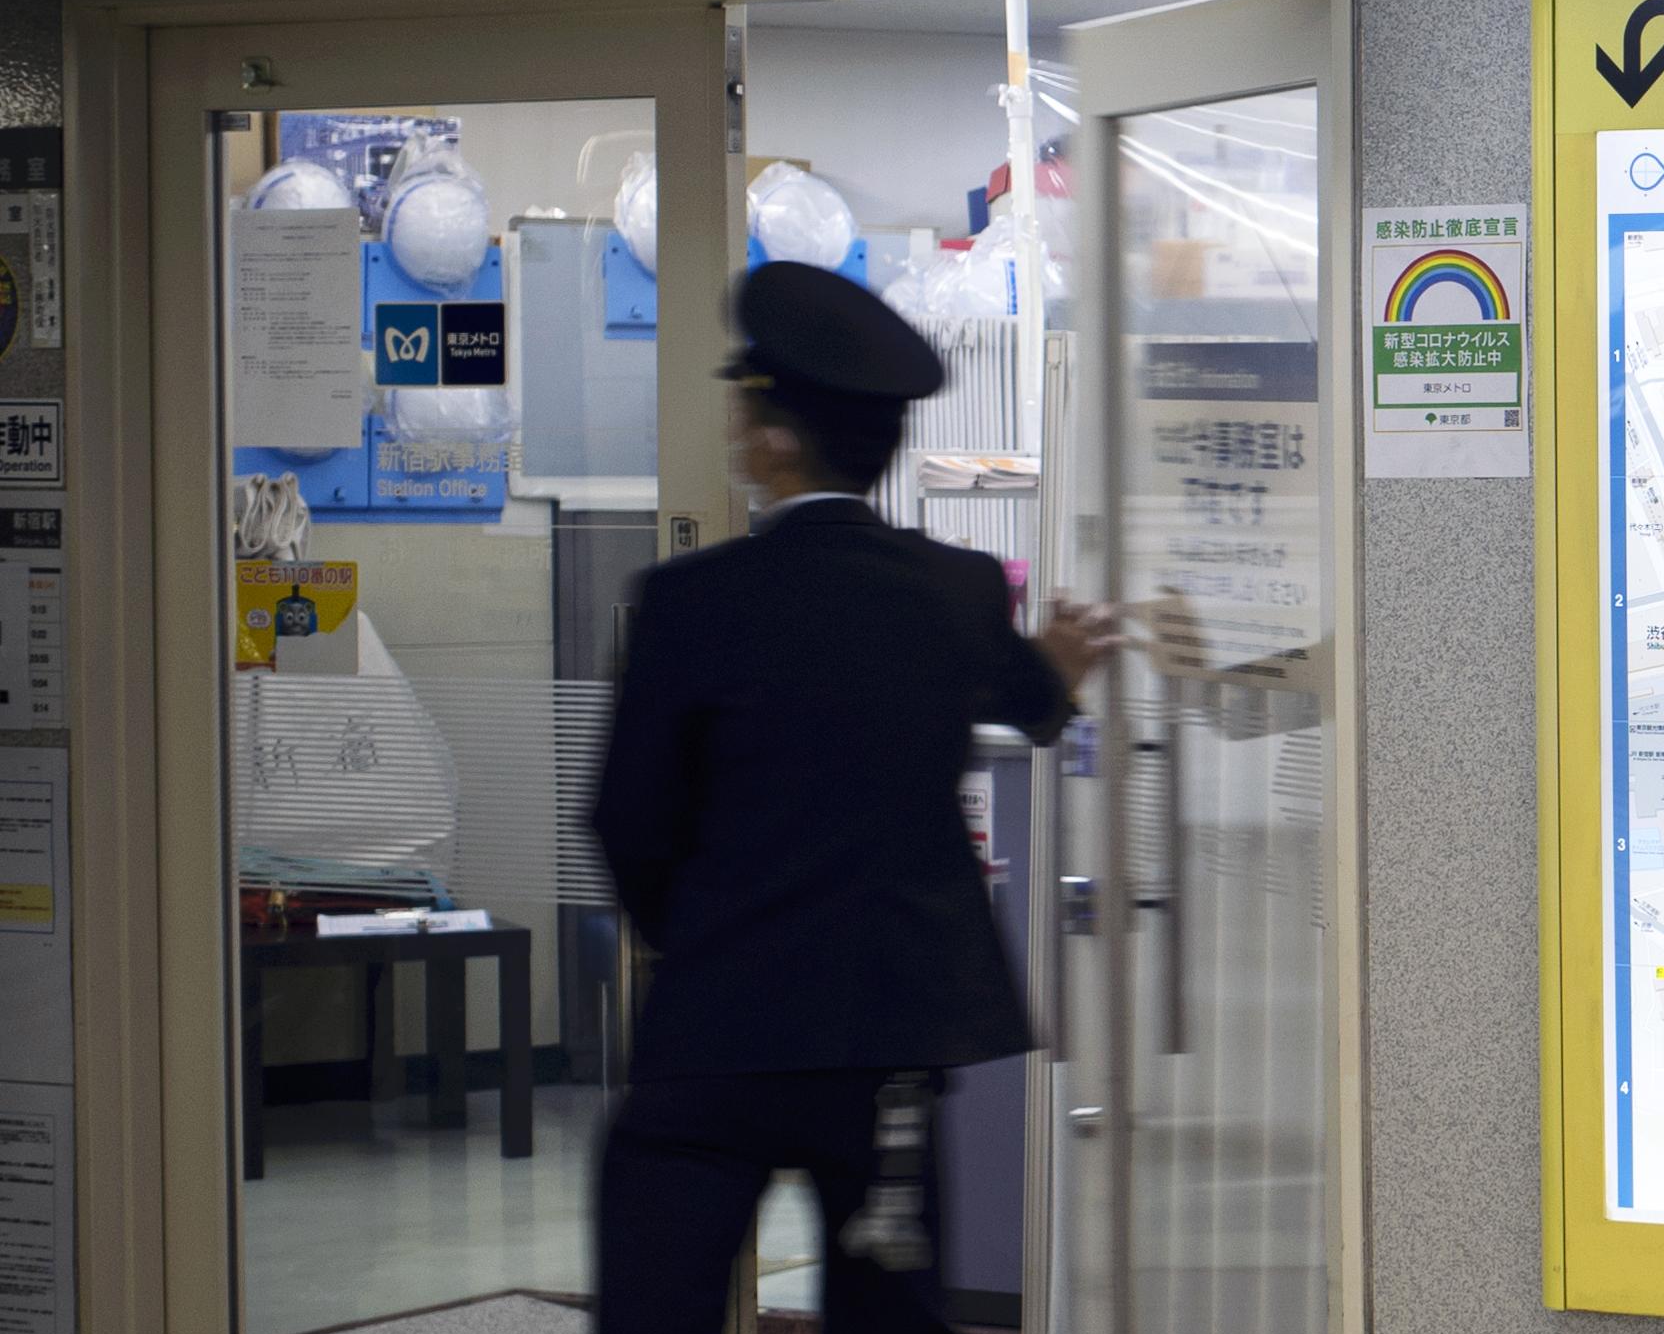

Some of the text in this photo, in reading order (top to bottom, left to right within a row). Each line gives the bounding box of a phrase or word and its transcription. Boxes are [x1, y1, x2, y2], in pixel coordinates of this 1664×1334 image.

[1376, 217, 1518, 239] 感染防止徹底宣言
[447, 333, 499, 345] 東京メトロ
[1384, 332, 1510, 349] 新型コロナウイルス
[451, 347, 496, 358] Tokyo Metro
[1394, 350, 1501, 367] 感染拡大防止中
[1424, 383, 1471, 393] 東京メトロ
[1440, 414, 1470, 425] 東京都
[376, 443, 524, 473] 新宿駅事務室
[378, 478, 489, 498] Station Office
[1618, 838, 1625, 851] 3
